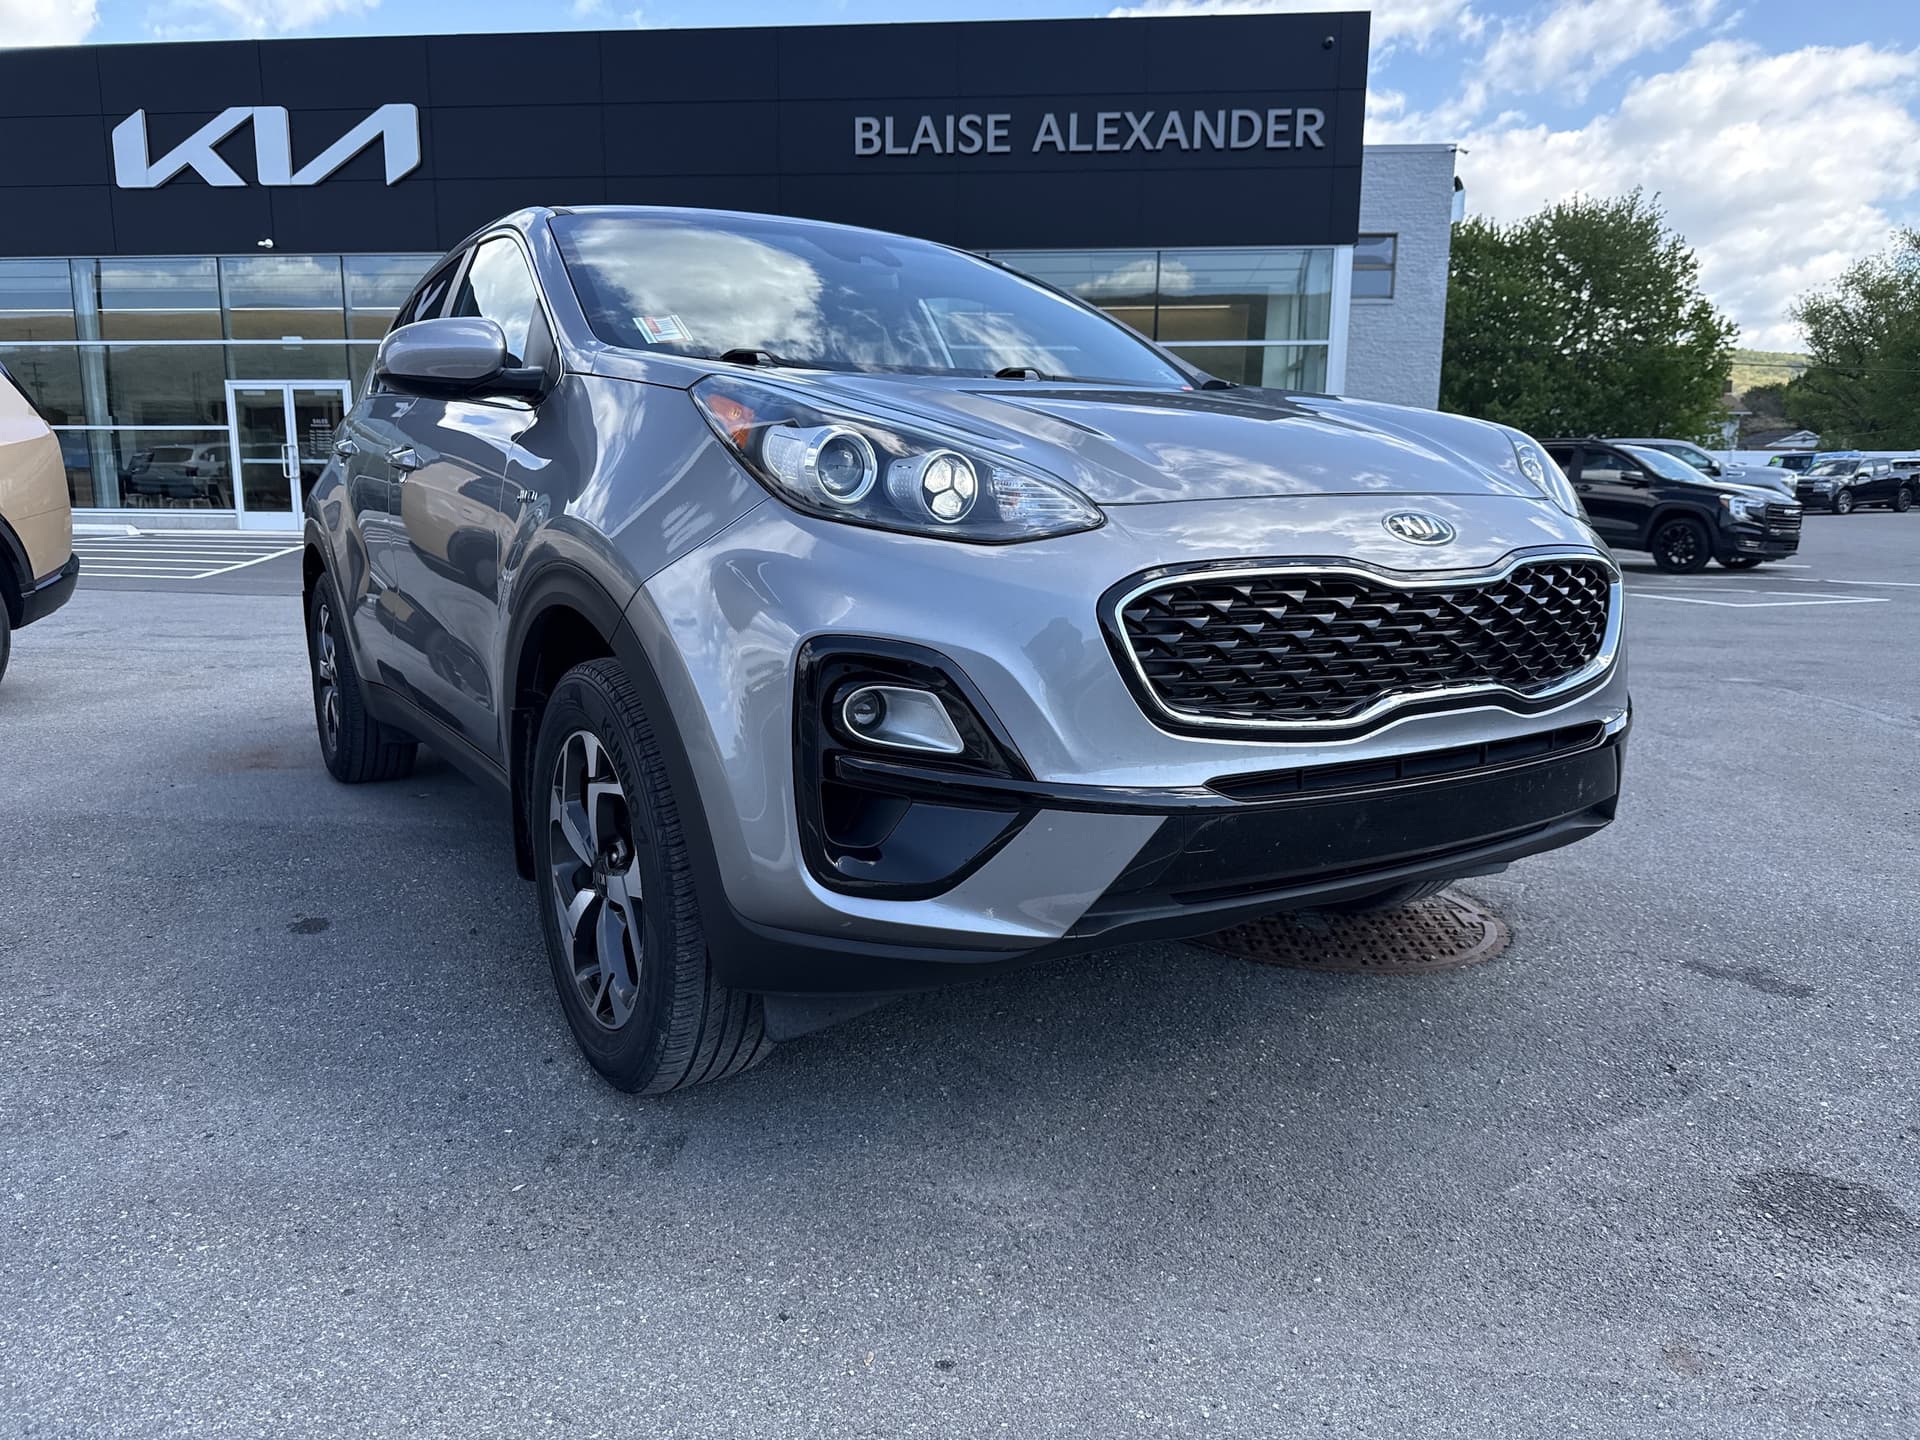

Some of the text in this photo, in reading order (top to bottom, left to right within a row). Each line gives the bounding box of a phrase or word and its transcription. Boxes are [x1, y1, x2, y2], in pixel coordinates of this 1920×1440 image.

[112, 103, 420, 188] KIA
[854, 107, 1326, 155] BLAISE ALEXANDER
[1393, 514, 1449, 536] KIA
